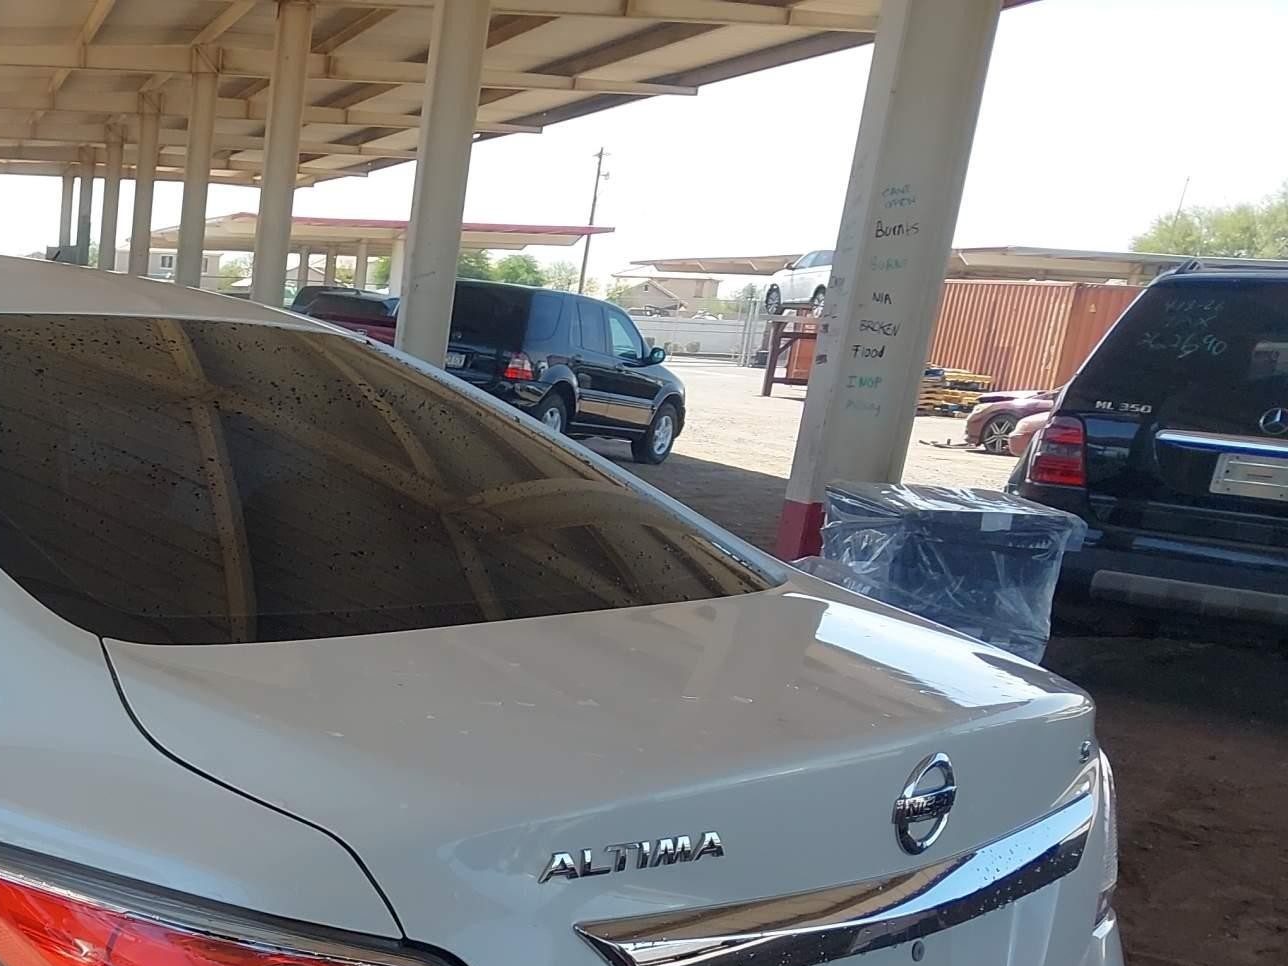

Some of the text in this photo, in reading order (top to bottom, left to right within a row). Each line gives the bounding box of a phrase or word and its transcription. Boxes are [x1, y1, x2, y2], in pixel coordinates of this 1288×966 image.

[859, 319, 900, 337] BROKEN
[851, 344, 886, 359] Flood
[1095, 400, 1152, 413] ML 350
[538, 831, 724, 884] ALTIMA
